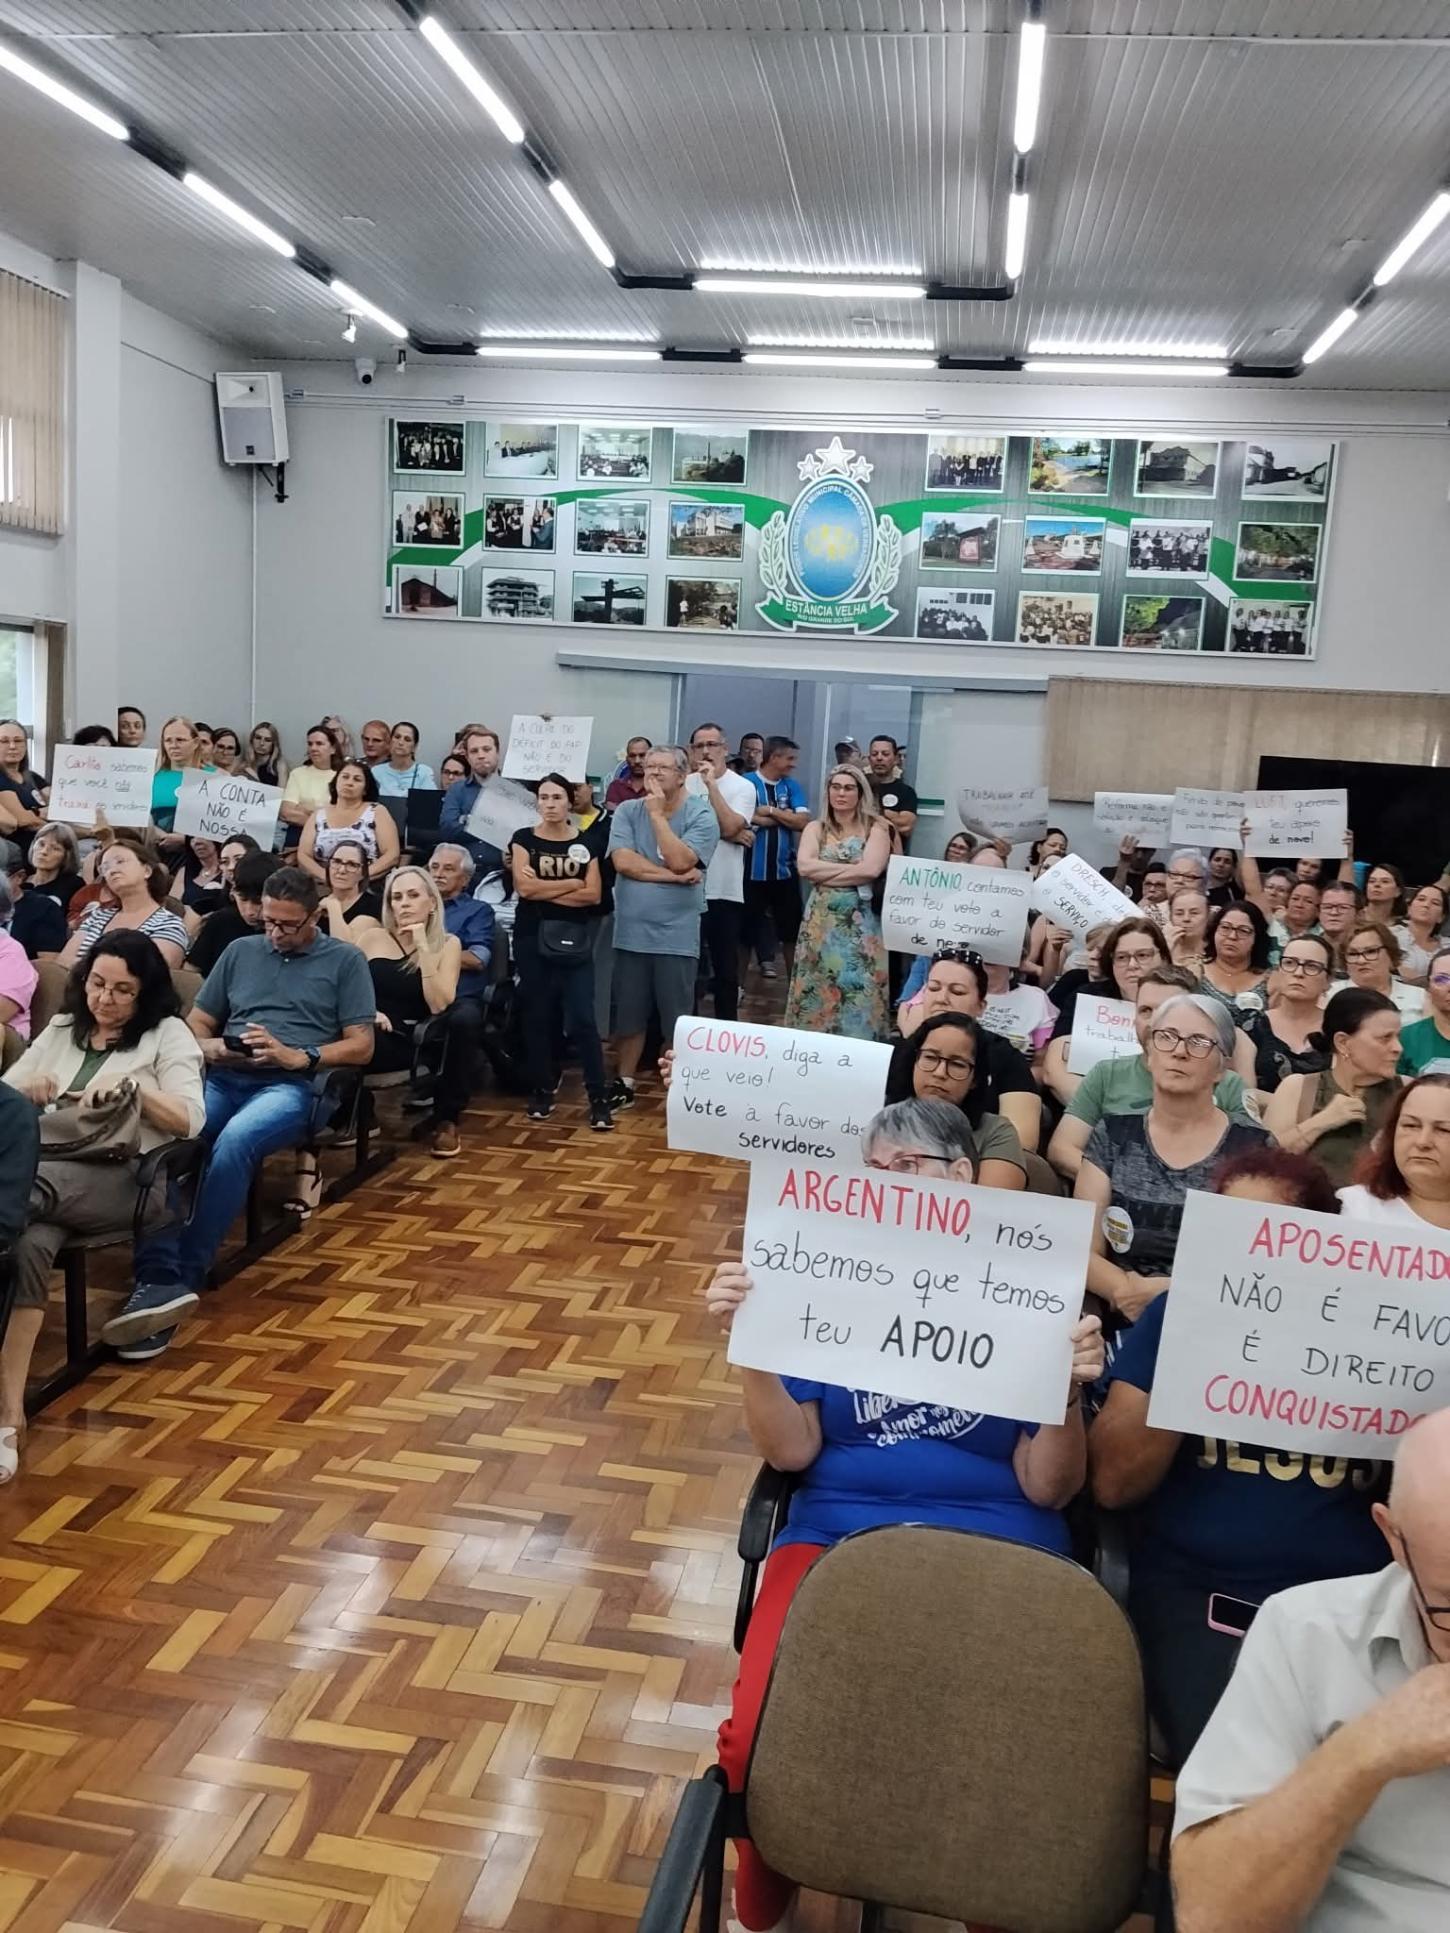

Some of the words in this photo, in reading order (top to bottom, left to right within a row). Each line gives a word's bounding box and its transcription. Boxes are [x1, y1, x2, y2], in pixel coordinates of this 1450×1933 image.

[785, 599, 832, 616] ESTÂNCIA
[835, 603, 867, 616] VELHA
[58, 777, 78, 789] que
[199, 780, 209, 796] A
[220, 783, 266, 807] CONTA
[207, 802, 231, 818] NÃO
[238, 808, 248, 822] É
[200, 820, 247, 836] NOSSA
[1268, 833, 1281, 845] de
[1287, 830, 1314, 845] novo!
[539, 856, 580, 877] RIO
[967, 878, 1024, 897] contamos
[889, 894, 914, 907] com
[923, 892, 944, 911] teu
[954, 900, 981, 914] voto
[991, 908, 1003, 919] a
[1054, 897, 1089, 928] SERVIÇO
[889, 909, 921, 925] favor
[929, 915, 946, 929] do
[952, 922, 1005, 937] servidor
[911, 932, 928, 946] de
[783, 1040, 822, 1077] diga
[837, 1054, 853, 1067] a
[681, 1066, 711, 1091] que
[726, 1066, 774, 1088] veio!
[683, 1095, 727, 1117] Vote
[775, 1102, 830, 1130] favor
[738, 1132, 836, 1158] servidores
[778, 1168, 971, 1244] ARGENTINO,
[995, 1222, 1053, 1251] nós
[1249, 1218, 1450, 1281] APOSENTAD
[750, 1231, 894, 1285] sabemos
[912, 1268, 960, 1308] que
[977, 1261, 1066, 1314] temos
[1220, 1272, 1282, 1312] NÃO
[1321, 1287, 1342, 1322] É
[1373, 1304, 1450, 1346] FAVO
[799, 1303, 851, 1345] teu
[880, 1314, 994, 1369] APOIO
[1243, 1329, 1262, 1362] É
[1301, 1347, 1434, 1392] DIREITO
